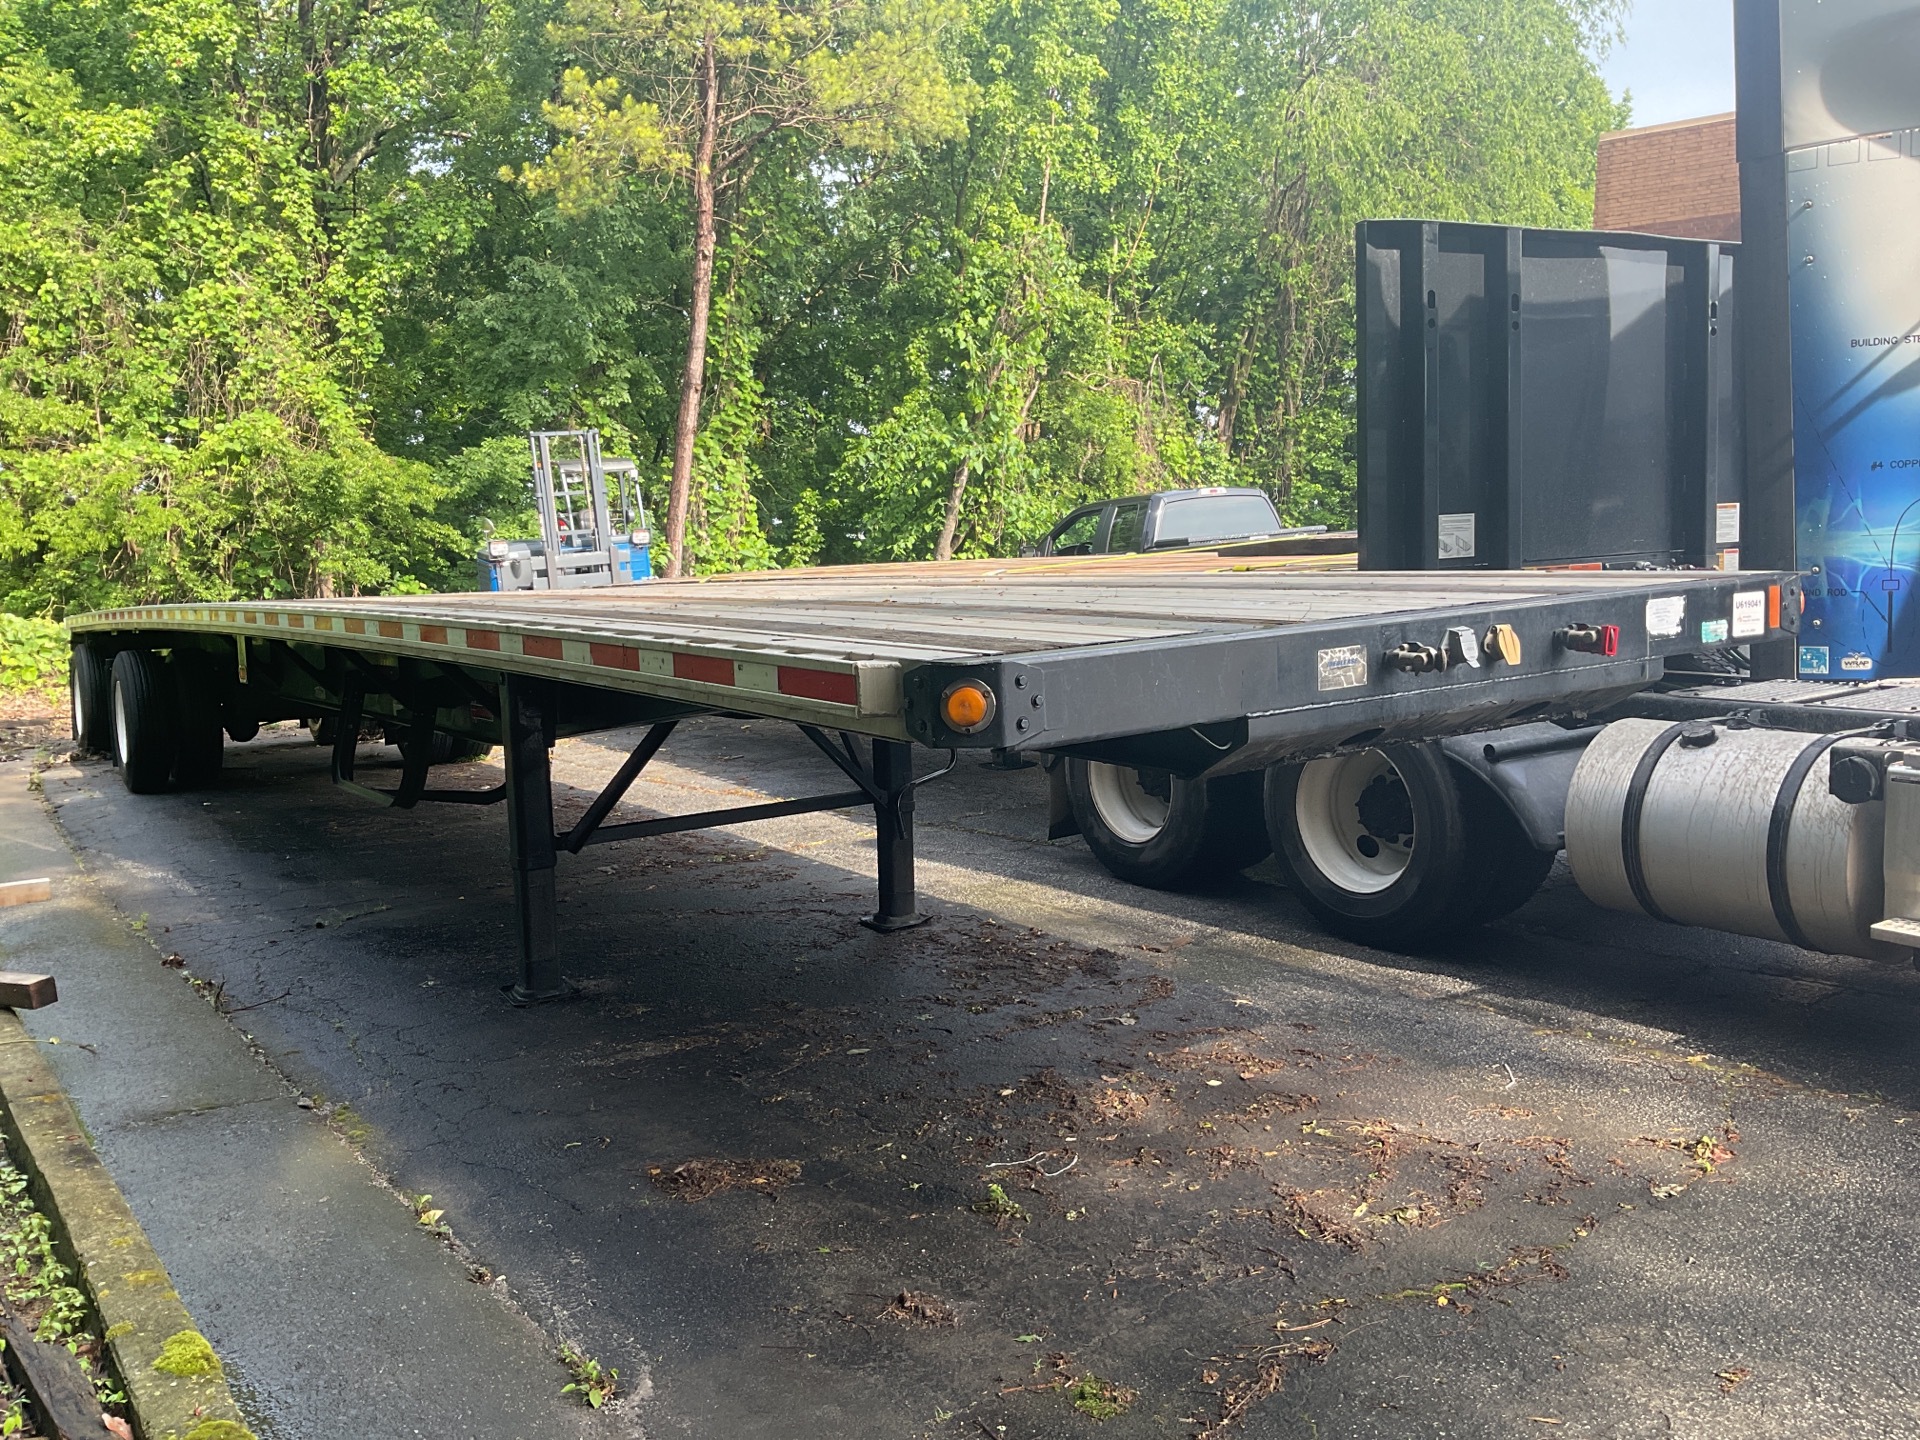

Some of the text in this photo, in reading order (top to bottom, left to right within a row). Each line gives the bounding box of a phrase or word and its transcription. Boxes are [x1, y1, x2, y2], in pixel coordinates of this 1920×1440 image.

[1850, 336, 1898, 348] BUILDING
[1871, 459, 1920, 471] #4 COPP
[1827, 588, 1847, 597] ROD
[1735, 599, 1761, 609] U619041
